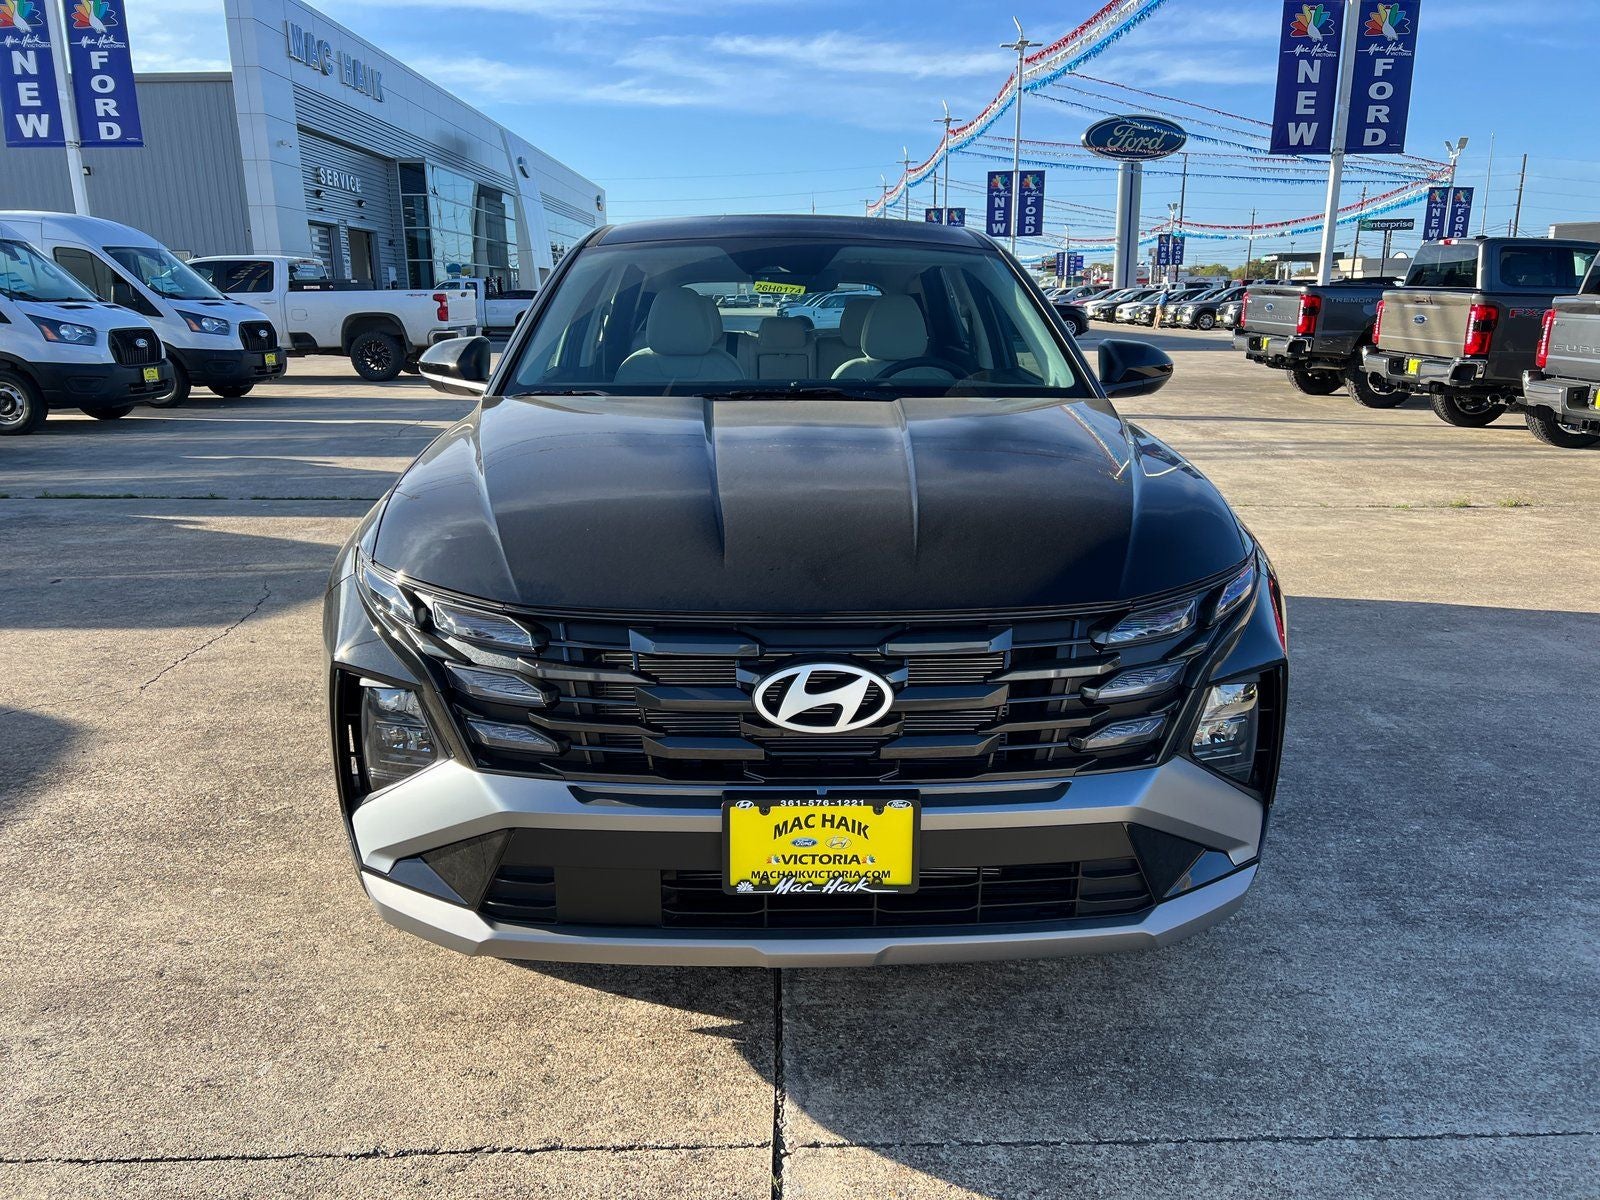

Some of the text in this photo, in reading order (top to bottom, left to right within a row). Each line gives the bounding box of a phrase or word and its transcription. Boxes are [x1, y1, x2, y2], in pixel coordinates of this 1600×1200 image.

[284, 20, 384, 103] MAC HAIK
[11, 51, 49, 138] NEW
[90, 51, 122, 140] FORD
[1288, 59, 1321, 146] NEW
[1363, 58, 1394, 146] FORD
[1106, 124, 1165, 151] Ford
[319, 167, 361, 193] SERVICE
[991, 197, 1006, 234] NEW
[1025, 196, 1036, 234] FORD
[1364, 221, 1414, 229] enterprise
[1429, 208, 1441, 238] NEW
[1453, 208, 1466, 238] FORD
[755, 283, 802, 294] 26H0174
[780, 799, 865, 807] 361-576-1221
[890, 800, 908, 808] Ford
[773, 813, 869, 840] MAC HAIK
[781, 854, 861, 865] VICTORIA
[751, 870, 891, 879] MACHAIKVICTORIA.COM
[774, 876, 880, 894] Mac Haik
